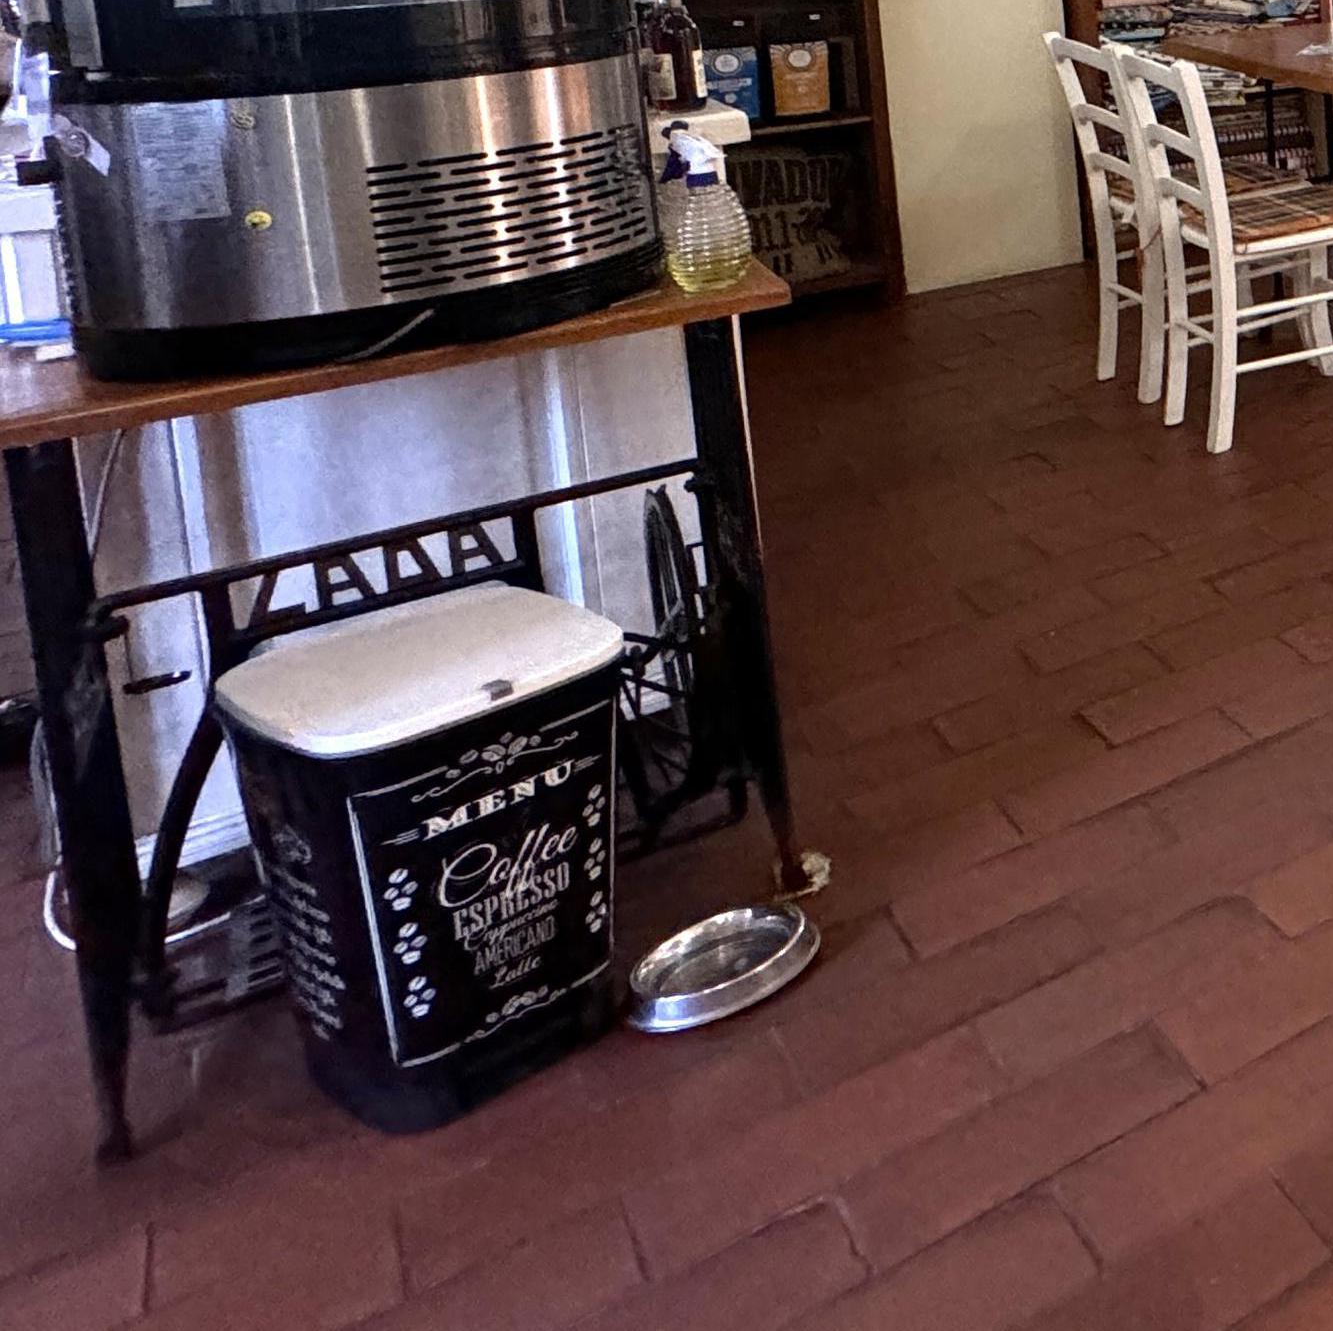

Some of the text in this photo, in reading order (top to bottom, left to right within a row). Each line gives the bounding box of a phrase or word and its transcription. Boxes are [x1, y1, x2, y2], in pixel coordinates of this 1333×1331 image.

[423, 759, 575, 841] MENU
[438, 822, 578, 908] Coffee
[452, 860, 571, 941] ESPRESSO
[473, 915, 557, 975] AMERICANO
[488, 955, 542, 990] Latte
